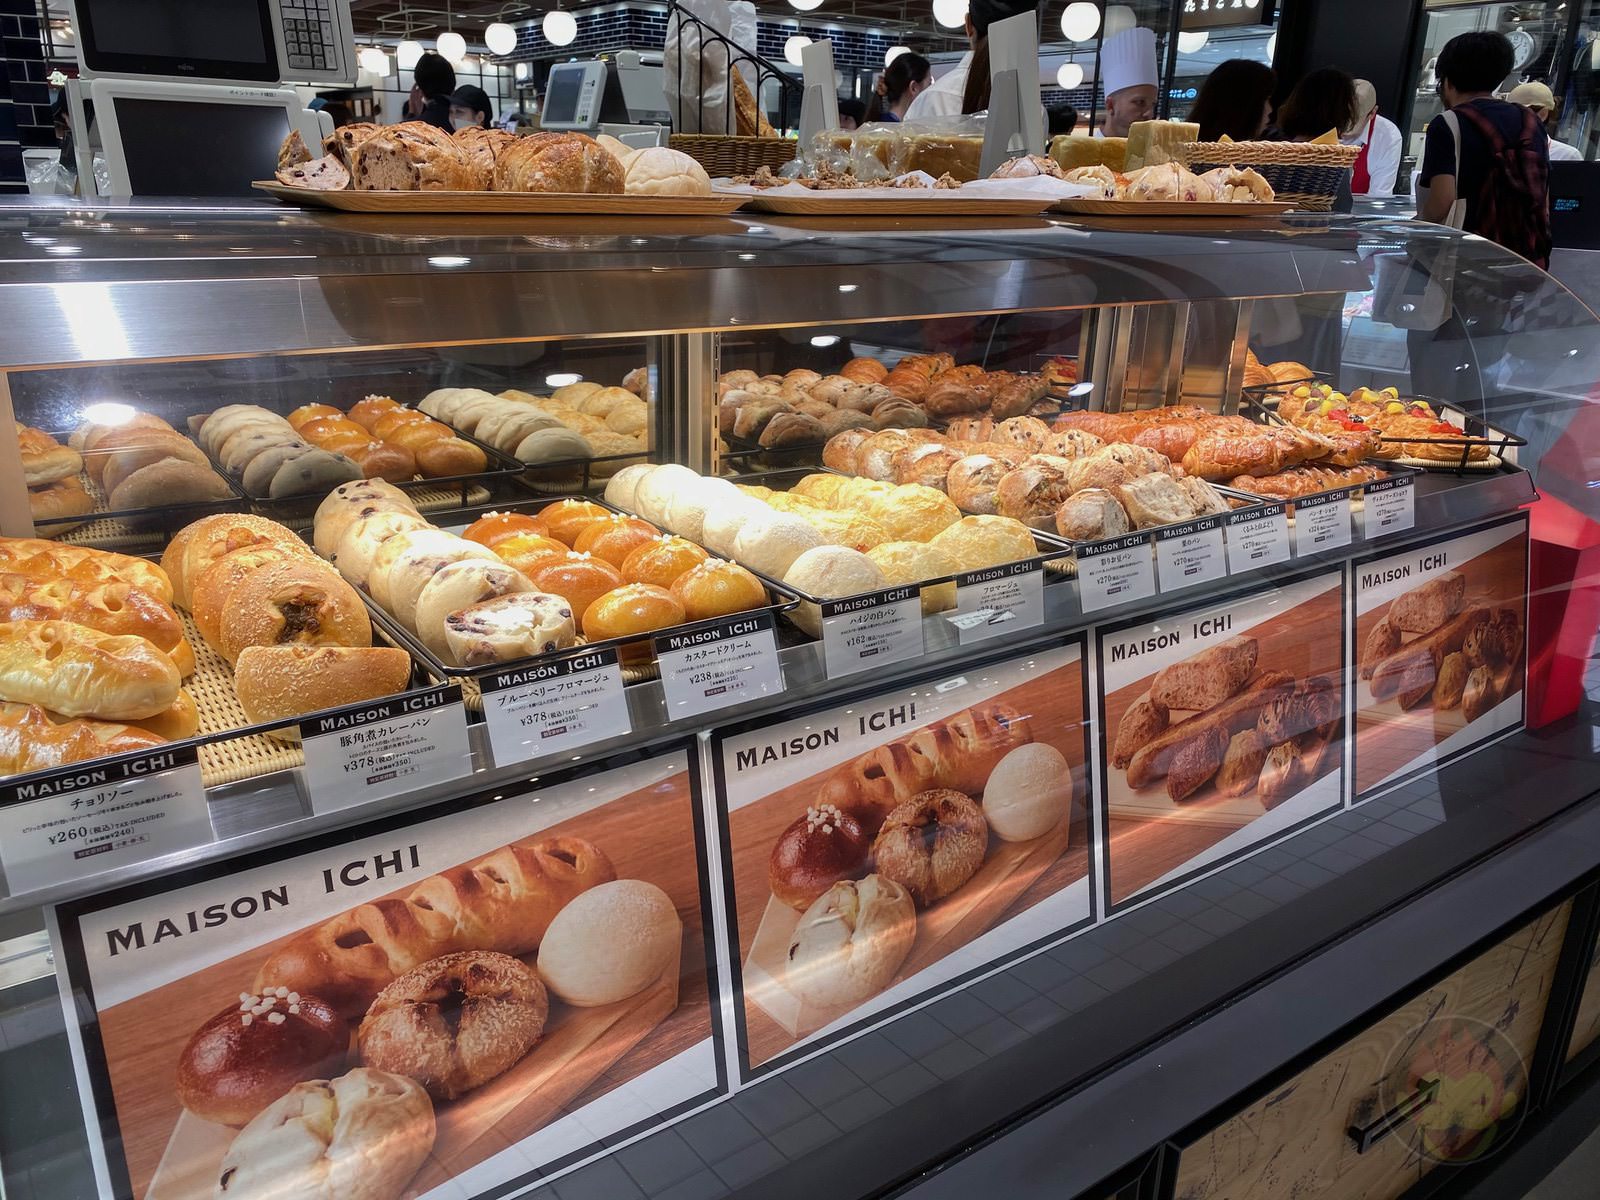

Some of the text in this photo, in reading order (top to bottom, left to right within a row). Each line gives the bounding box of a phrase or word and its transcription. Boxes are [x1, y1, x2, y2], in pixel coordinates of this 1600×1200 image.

[1370, 477, 1409, 492] MAISON ICHI
[1301, 491, 1344, 508] MAISON ICHI
[1233, 506, 1280, 523] MAISON ICHI
[1163, 519, 1215, 538] MAISON ICHI
[1085, 536, 1143, 555] MAISON ICHI
[967, 561, 1033, 584] MAISON ICHI
[1362, 552, 1448, 590] MAISON ICHI
[983, 581, 1018, 595] フロマージュ
[834, 588, 909, 614] MAISON ICHI
[849, 608, 897, 625] ハイジの白パン
[670, 620, 759, 649] MAISON ICHI
[847, 635, 866, 647] ¥162
[1111, 614, 1233, 662] MAISON ICHI
[684, 640, 752, 662] カスタードクリーム
[497, 654, 603, 687] MAISON ICHI
[689, 671, 712, 685] ¥238
[497, 674, 610, 708] ブルーベリーフロマージュ
[320, 692, 445, 732] MAISON ICHI
[520, 711, 548, 726] ¥378
[339, 717, 432, 748] 豚角煮カレーパン
[735, 702, 917, 772] MAISON ICHI
[343, 756, 374, 773] ¥378
[15, 753, 176, 801] MAISON ICHI
[70, 790, 134, 811] チョリソー
[48, 827, 88, 846] ¥260
[105, 843, 421, 958] MAISON ICHI
